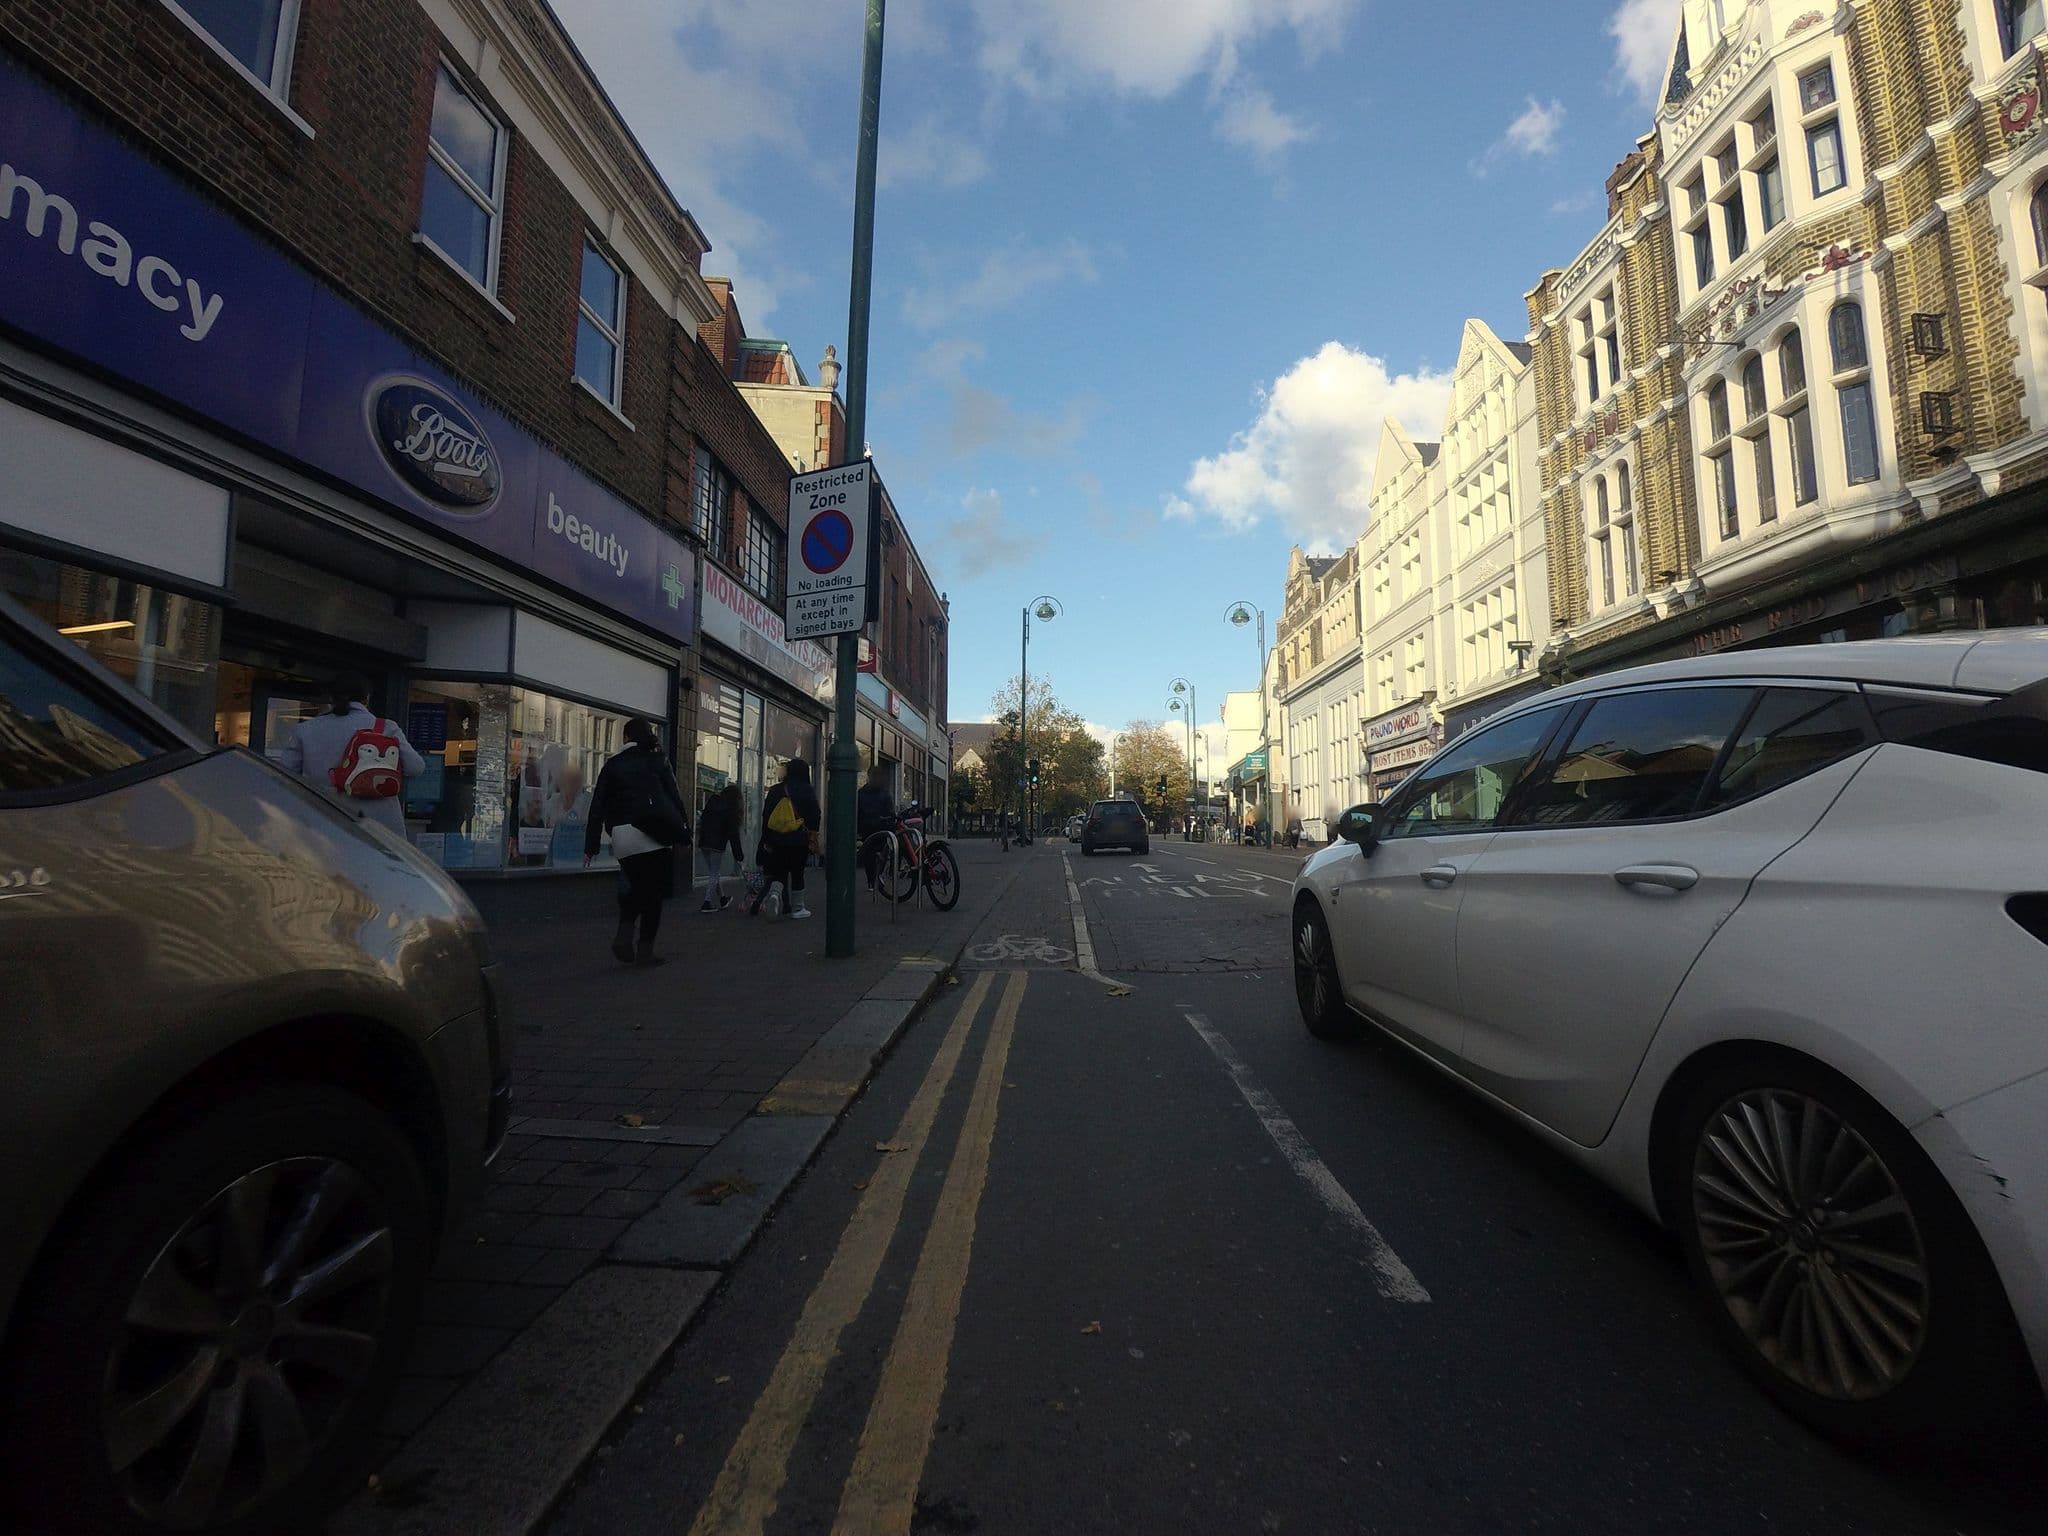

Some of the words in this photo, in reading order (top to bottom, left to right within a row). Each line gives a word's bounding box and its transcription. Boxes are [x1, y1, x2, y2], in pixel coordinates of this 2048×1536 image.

[392, 402, 490, 479] Boots
[795, 469, 864, 494] Restricted
[809, 492, 847, 510] Zone
[547, 492, 630, 577] beauty
[798, 580, 812, 591] No
[815, 575, 853, 590] loading
[795, 598, 807, 610] At
[810, 595, 827, 608] any
[832, 592, 855, 604] time
[801, 608, 835, 621] except
[838, 604, 848, 617] in
[795, 621, 827, 636] signed
[830, 617, 854, 632] bays
[1693, 623, 1744, 656] THE
[1373, 754, 1391, 769] MOST
[1393, 745, 1417, 763] ITEMS
